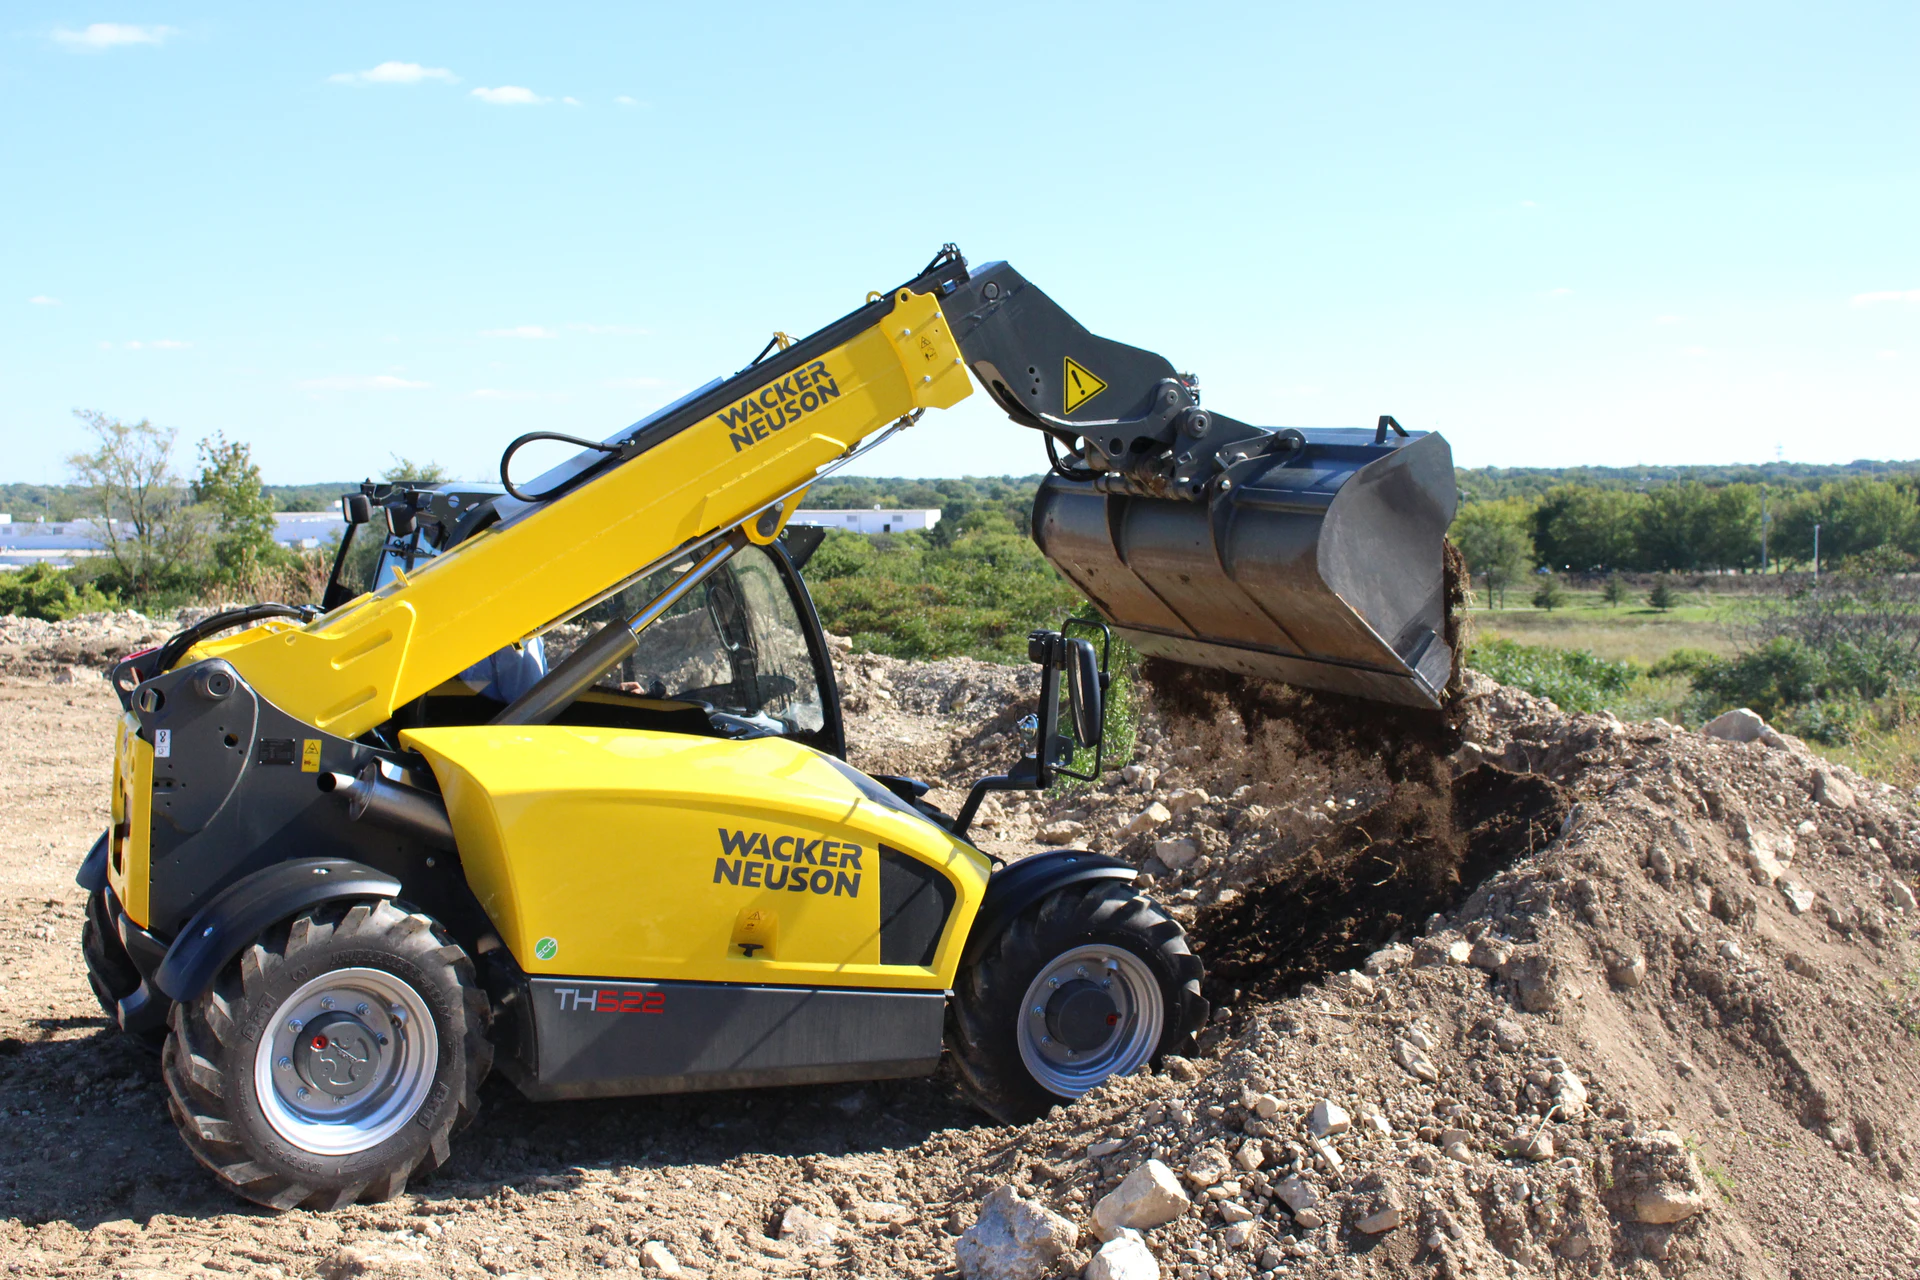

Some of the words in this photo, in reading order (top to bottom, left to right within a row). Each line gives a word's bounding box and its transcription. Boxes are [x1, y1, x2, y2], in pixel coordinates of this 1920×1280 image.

[717, 360, 832, 430] WACKER
[729, 378, 841, 453] NEUSON
[718, 828, 863, 870] WACKER
[713, 858, 861, 898] NEUSON
[536, 938, 557, 959] ECO
[554, 988, 666, 1013] TH522
